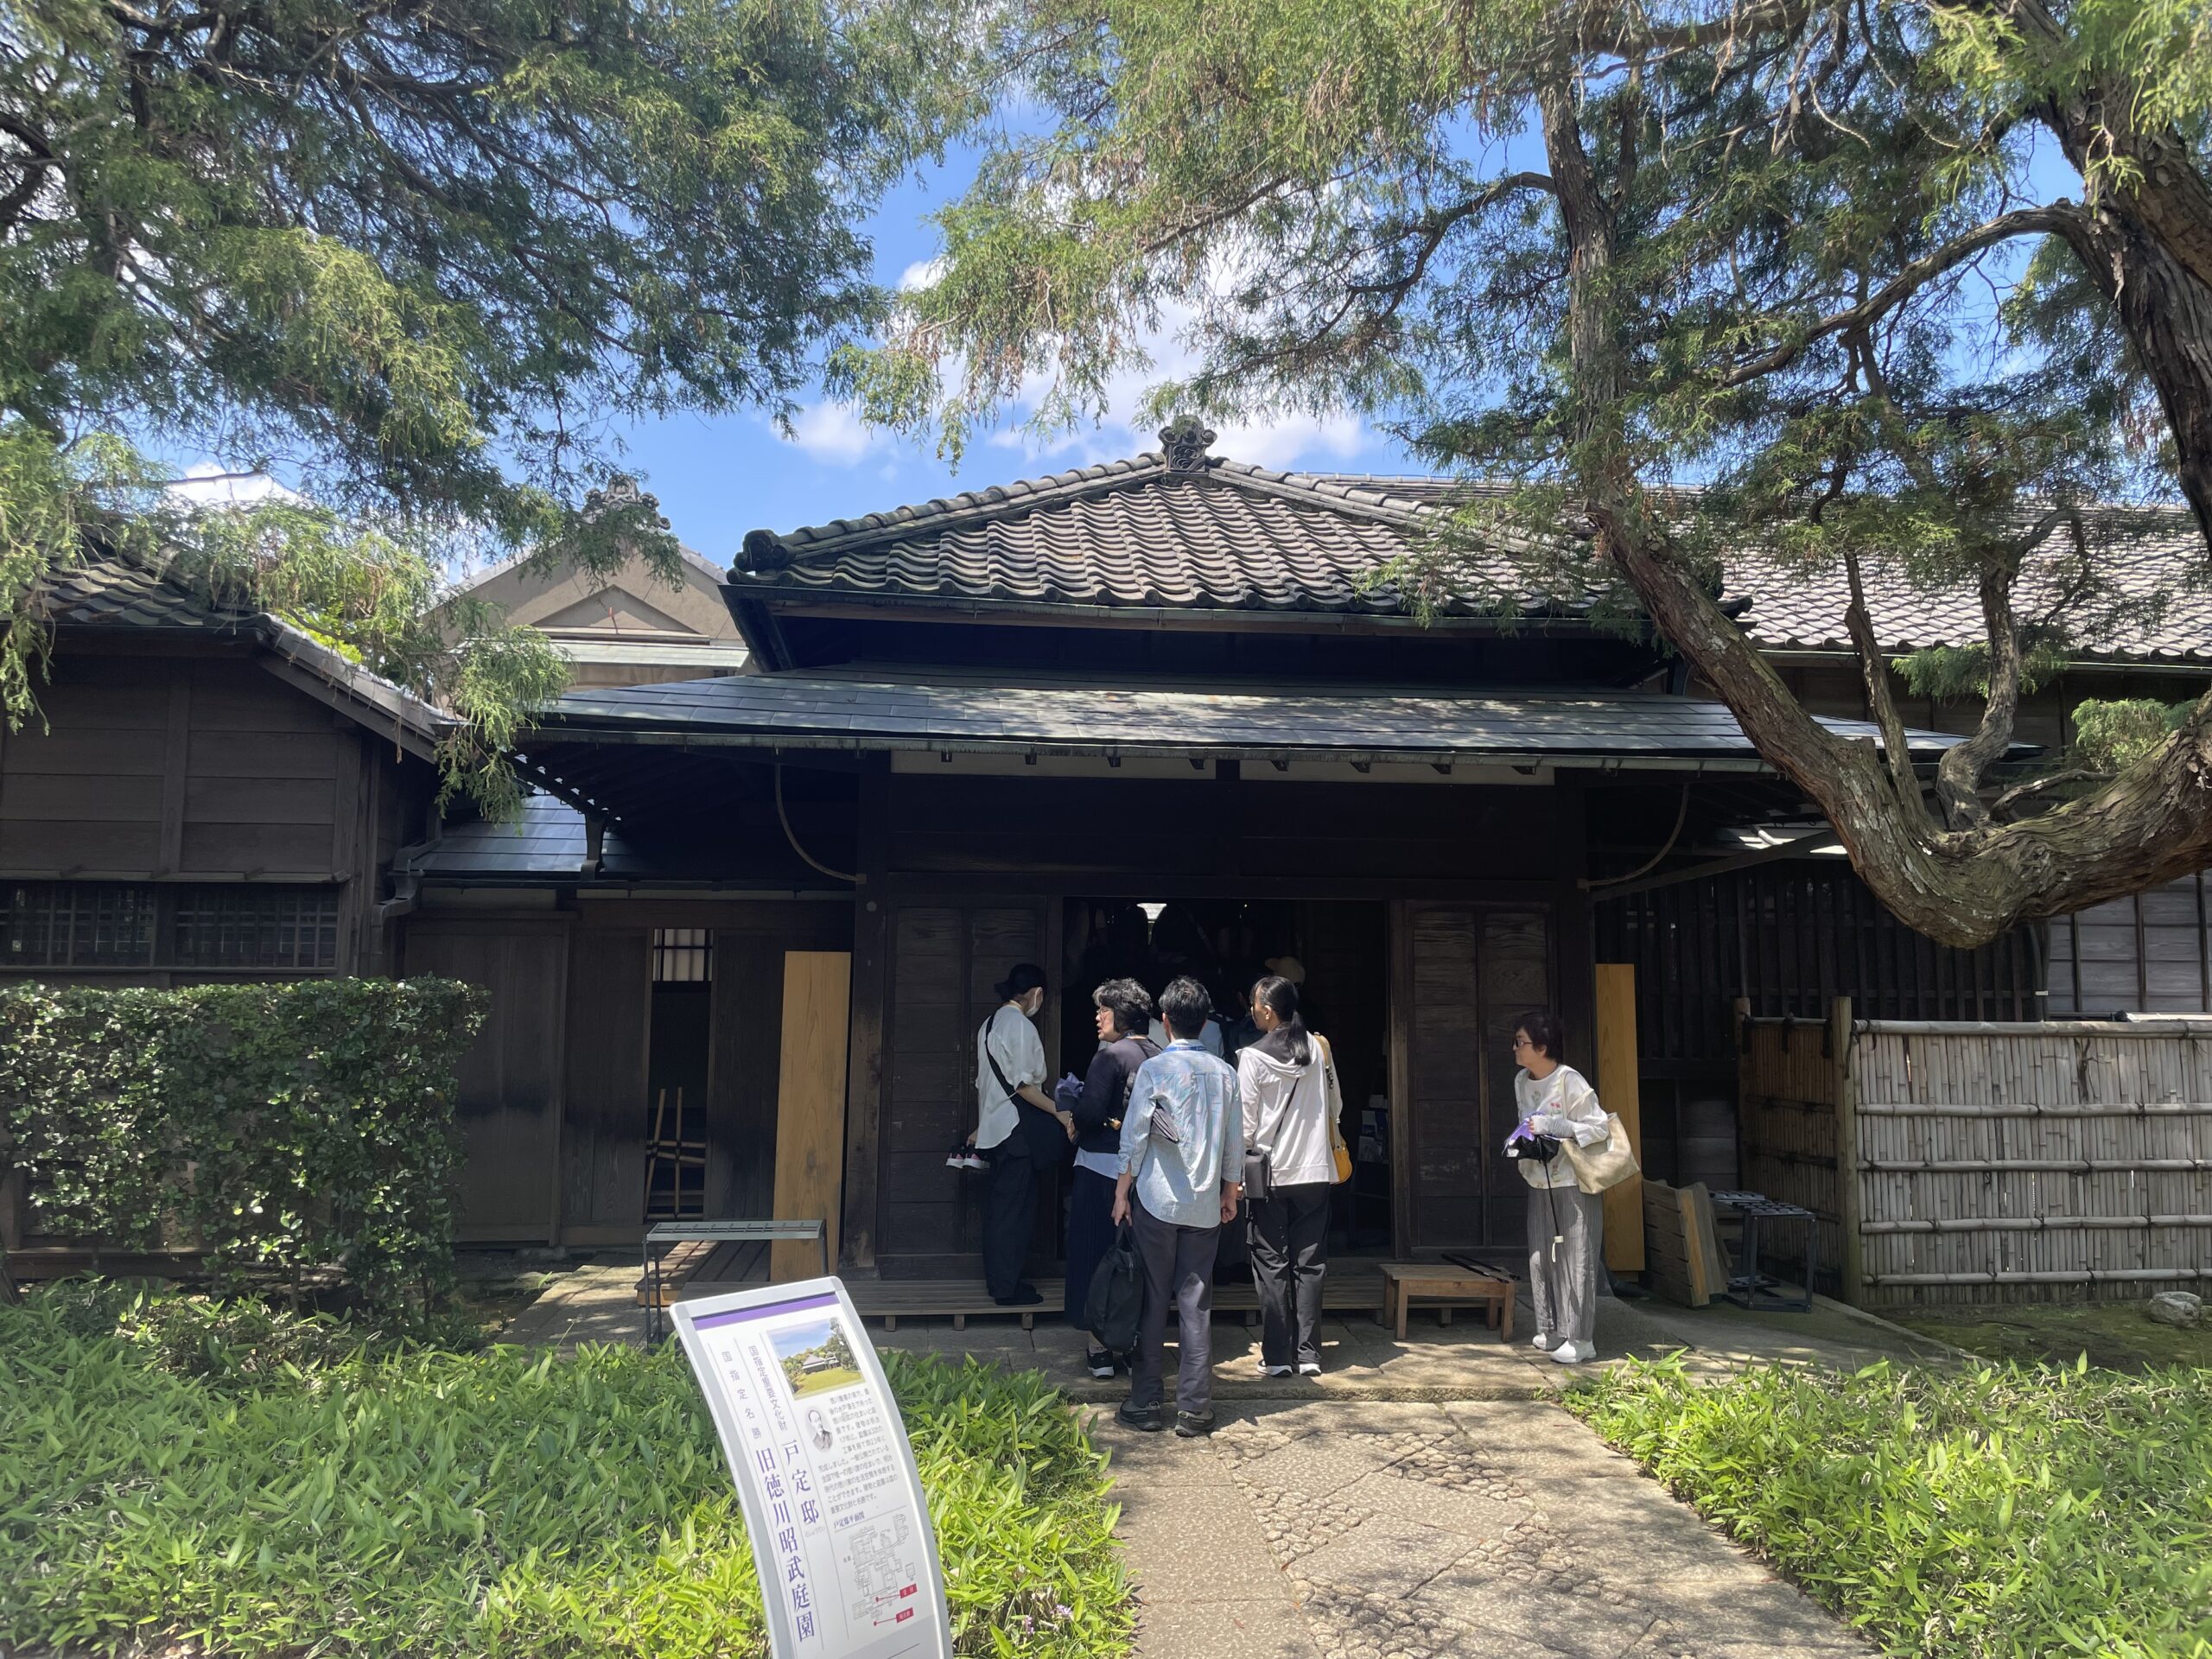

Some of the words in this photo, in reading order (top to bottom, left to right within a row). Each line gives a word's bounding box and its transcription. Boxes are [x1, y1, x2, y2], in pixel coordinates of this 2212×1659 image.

[721, 1351, 761, 1439] 国指定名勝
[781, 1440, 819, 1526] 戸定邸
[755, 1447, 815, 1642] 旧徳川昭武庭園
